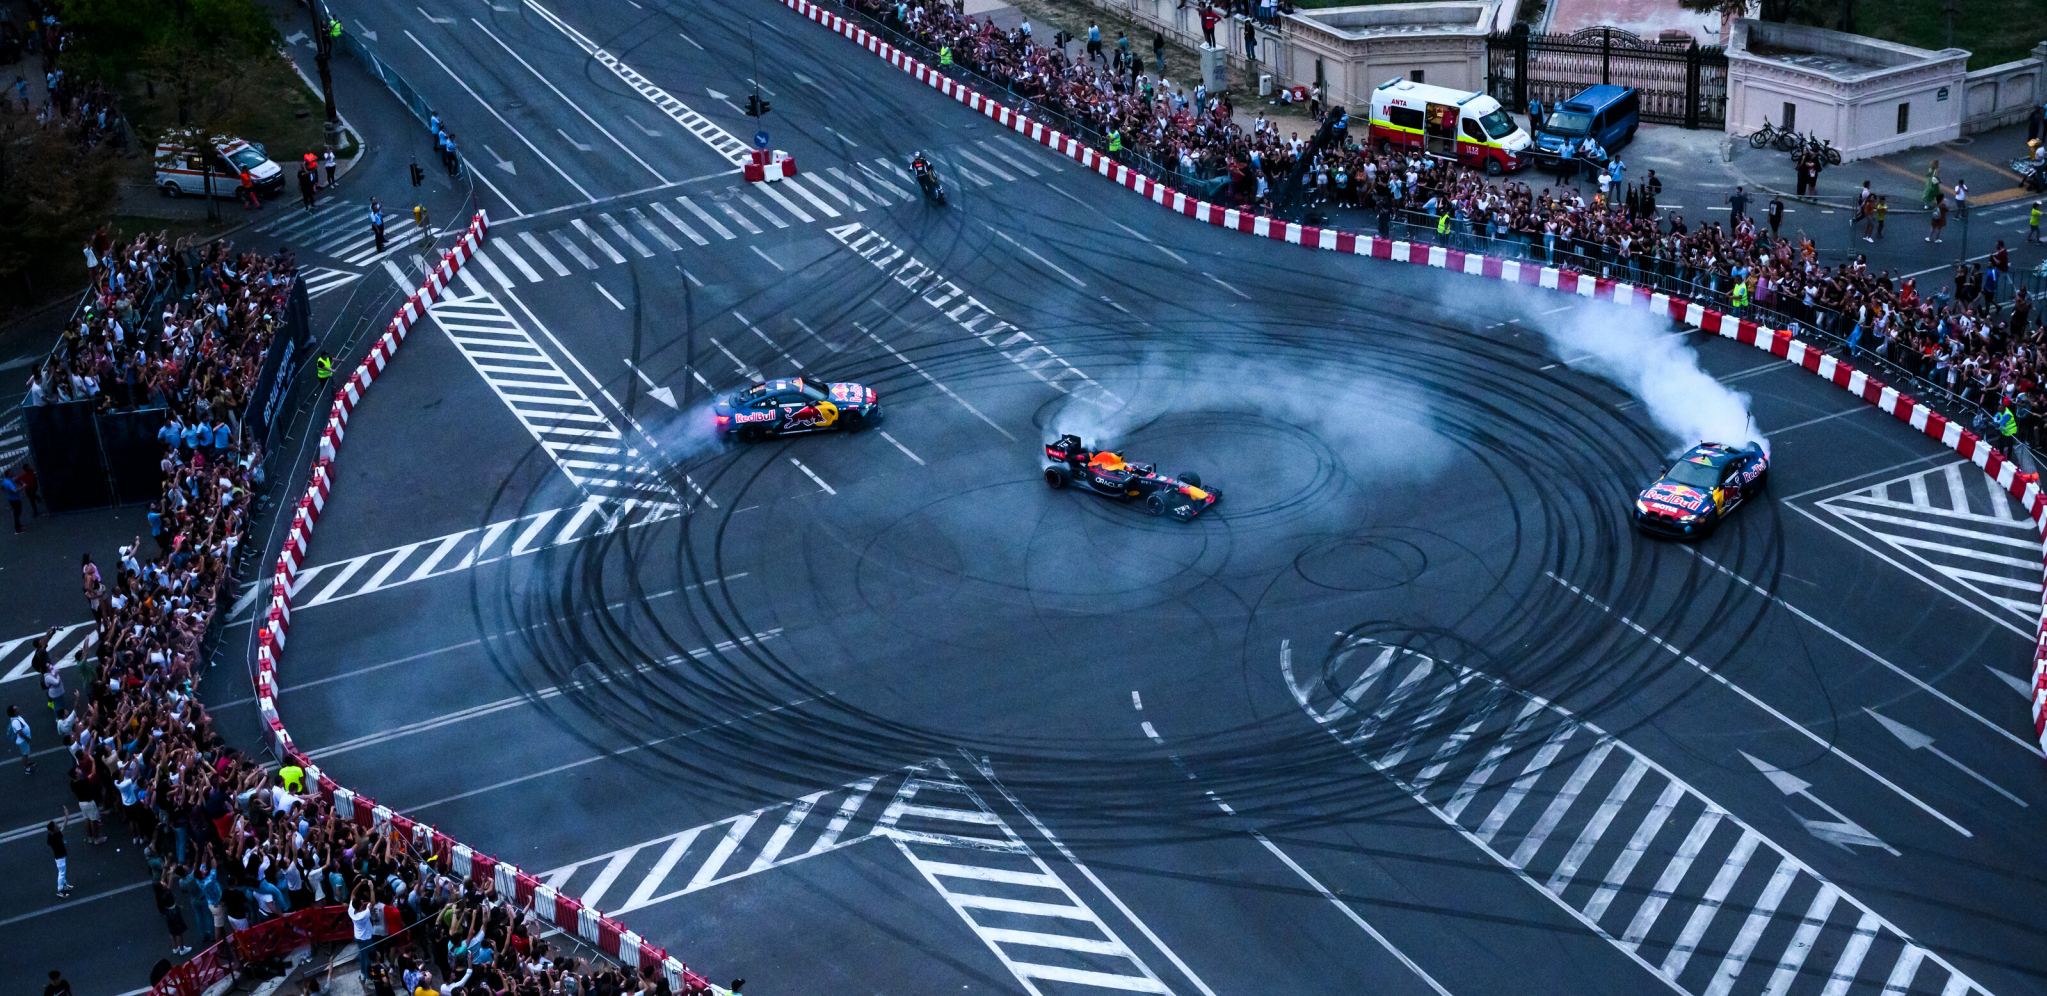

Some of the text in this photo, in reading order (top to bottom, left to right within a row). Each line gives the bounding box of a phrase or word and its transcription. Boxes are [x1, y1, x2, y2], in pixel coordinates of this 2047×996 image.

[1391, 98, 1407, 106] ANTA
[735, 409, 776, 424] Red Bull
[1743, 465, 1759, 483] Red
[1095, 476, 1124, 489] ORACLE
[1644, 489, 1702, 511] Red Bull
[1651, 502, 1678, 514] MOTUL
